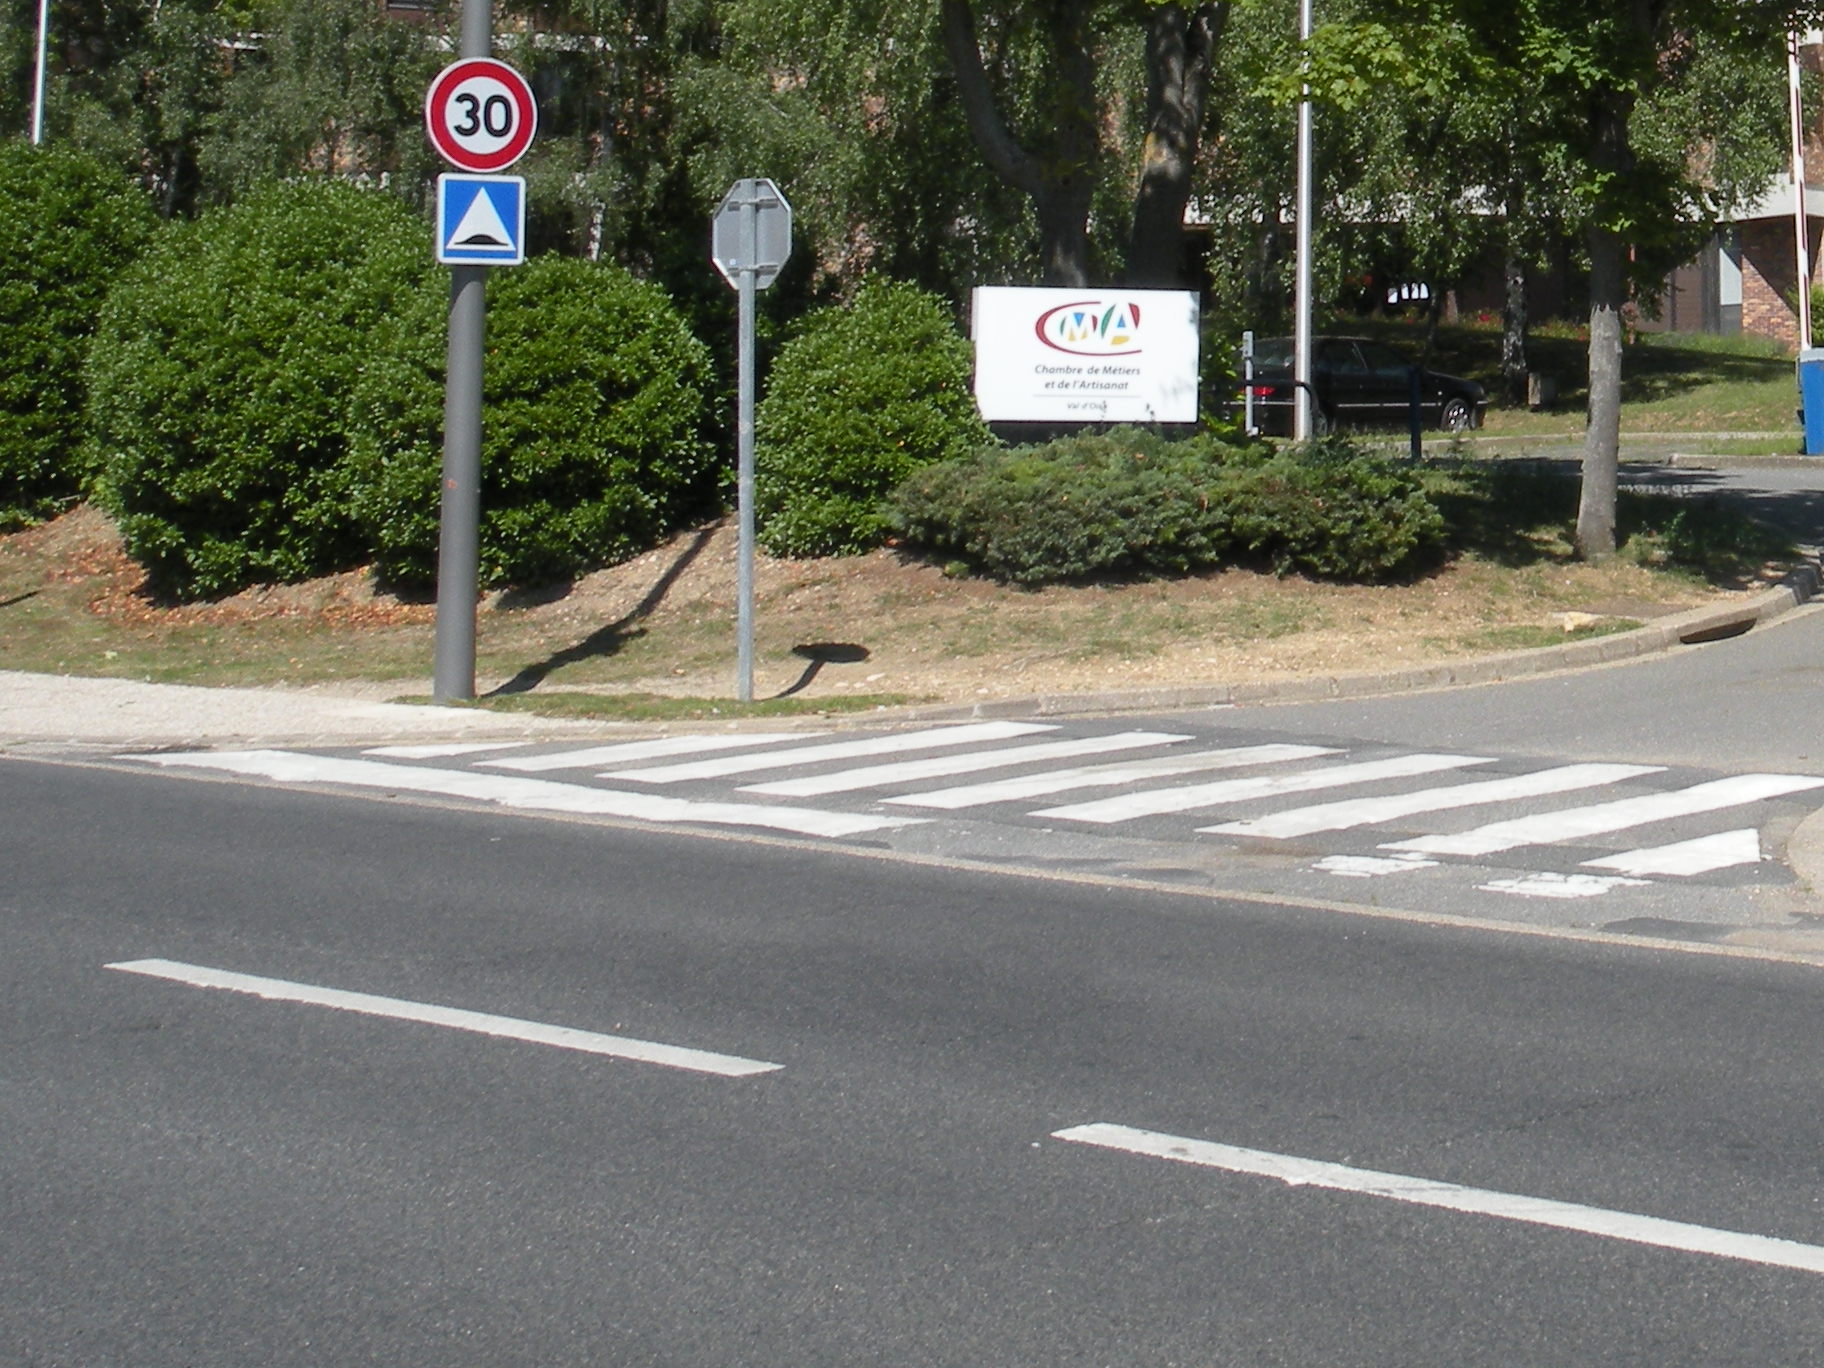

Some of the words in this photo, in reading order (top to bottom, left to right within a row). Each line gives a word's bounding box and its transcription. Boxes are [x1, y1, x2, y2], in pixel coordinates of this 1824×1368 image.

[453, 92, 513, 138] 30
[1034, 301, 1143, 356] CMA
[1034, 364, 1083, 375] Chambre
[1087, 365, 1100, 375] de
[1102, 364, 1141, 376] Métiers
[1044, 380, 1056, 390] et
[1057, 380, 1071, 390] de
[1072, 379, 1129, 390] l'Artisanat
